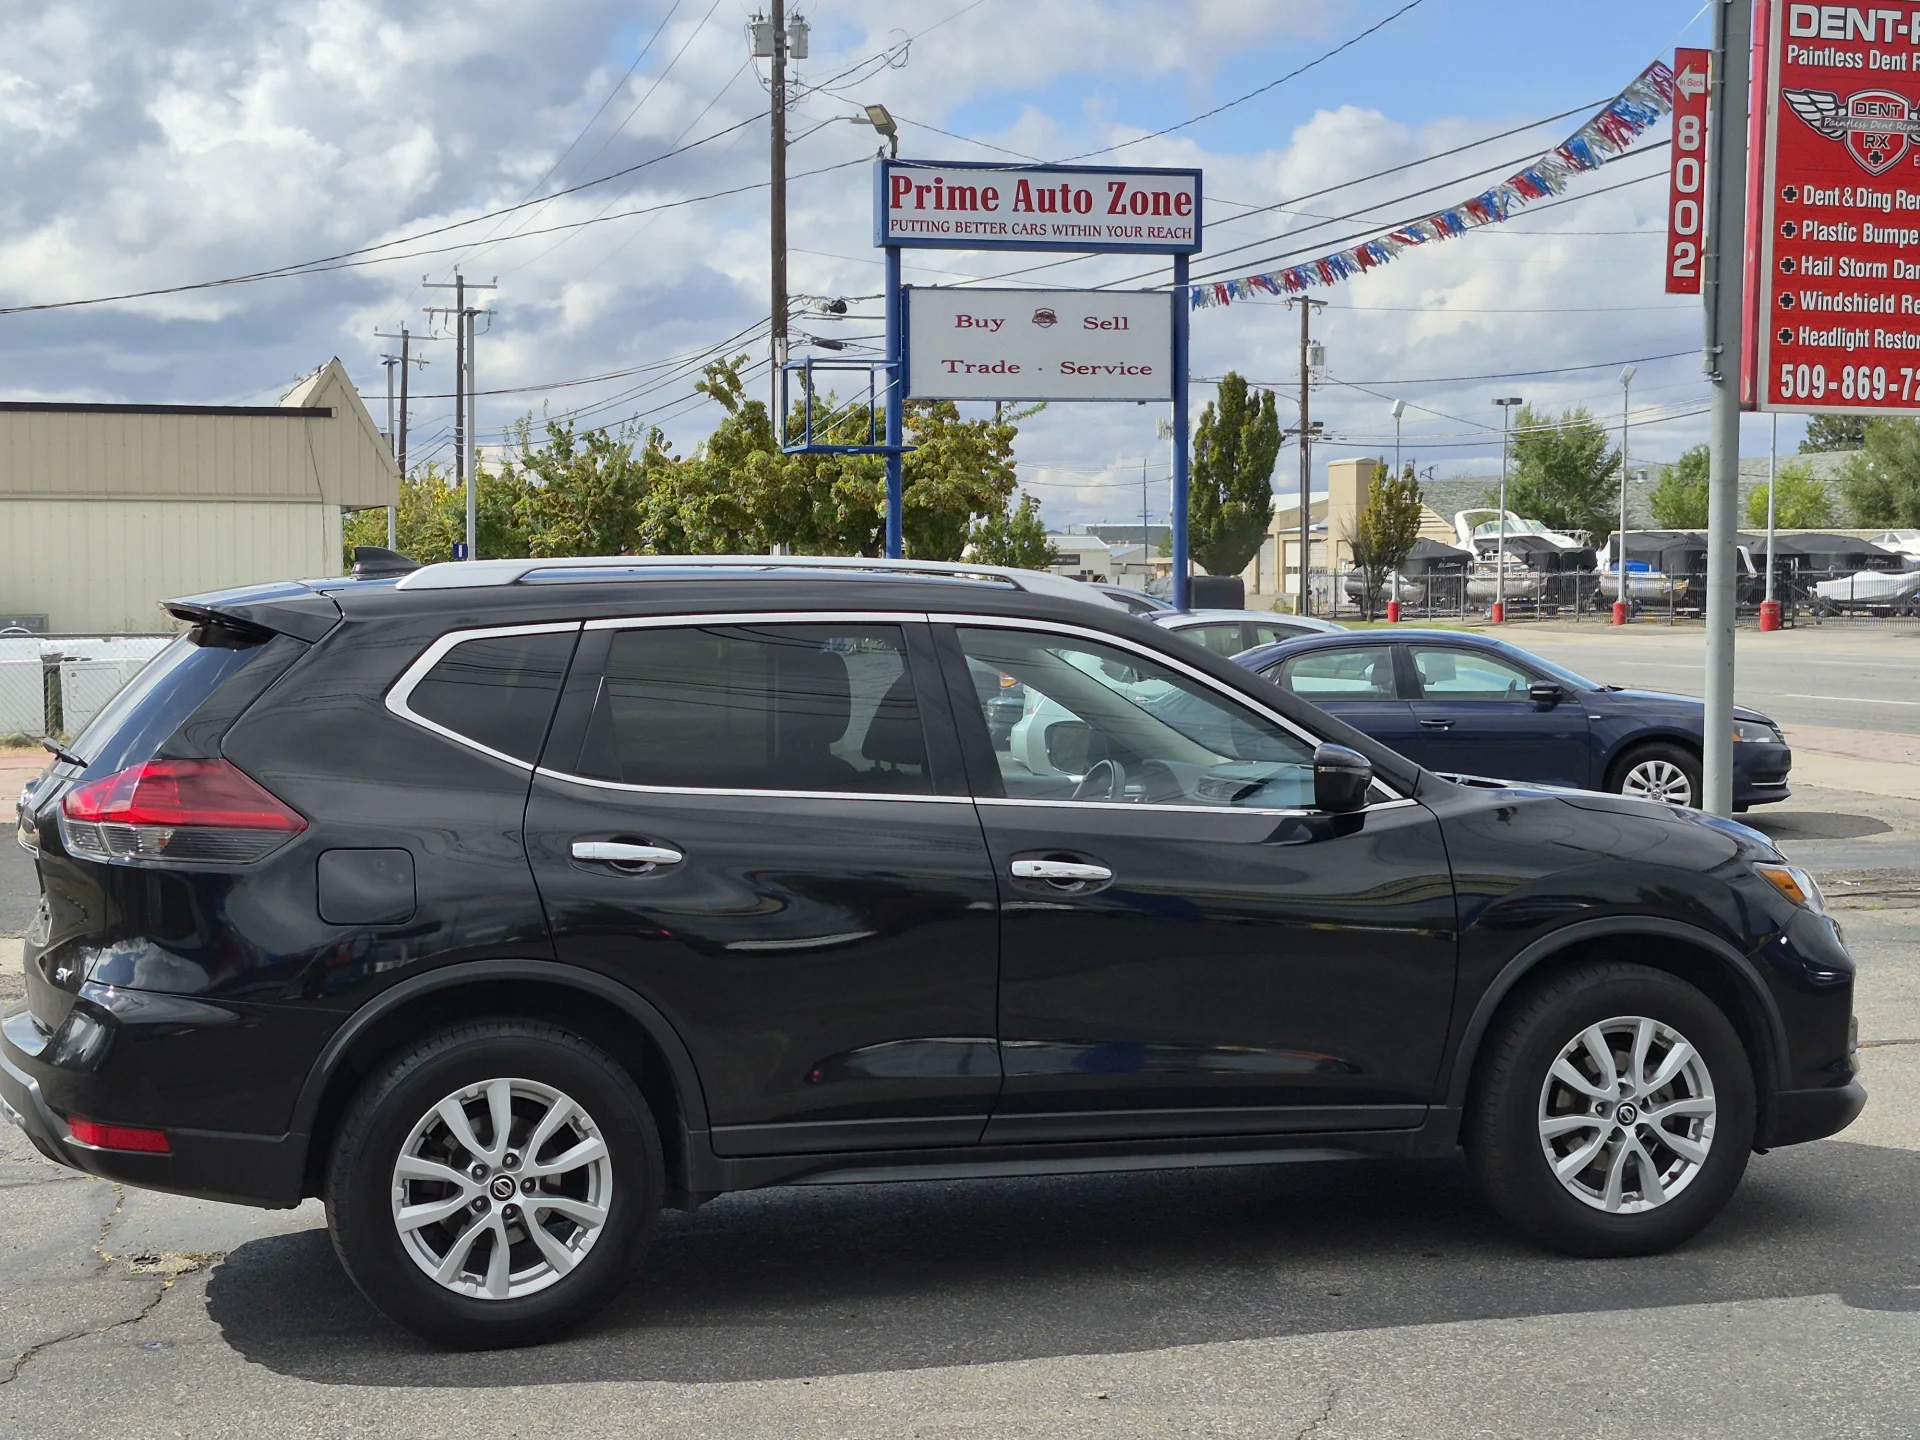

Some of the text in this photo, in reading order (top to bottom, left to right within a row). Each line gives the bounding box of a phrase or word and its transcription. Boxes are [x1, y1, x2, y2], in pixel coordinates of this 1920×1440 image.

[1787, 44, 1863, 69] Paintless
[1869, 50, 1907, 71] Dent
[1855, 102, 1901, 118] DENT
[1824, 117, 1868, 130] Paintless
[1870, 120, 1894, 131] Dent
[1864, 133, 1891, 150] RX
[890, 175, 1192, 217] Prime Auto Zone
[1672, 114, 1700, 278] 8002
[1856, 187, 1891, 213] Ding
[1895, 189, 1920, 211] Re
[890, 219, 1192, 239] PUTTING BETTER CARS WITHIN YOUR REACH
[1801, 220, 1857, 242] Plastic
[1801, 255, 1920, 280] Hail Storm Da
[1799, 290, 1895, 314] Windshield
[955, 314, 1130, 333] Buy Sell
[1798, 325, 1870, 352] Headlight
[941, 359, 1153, 376] Trade Service
